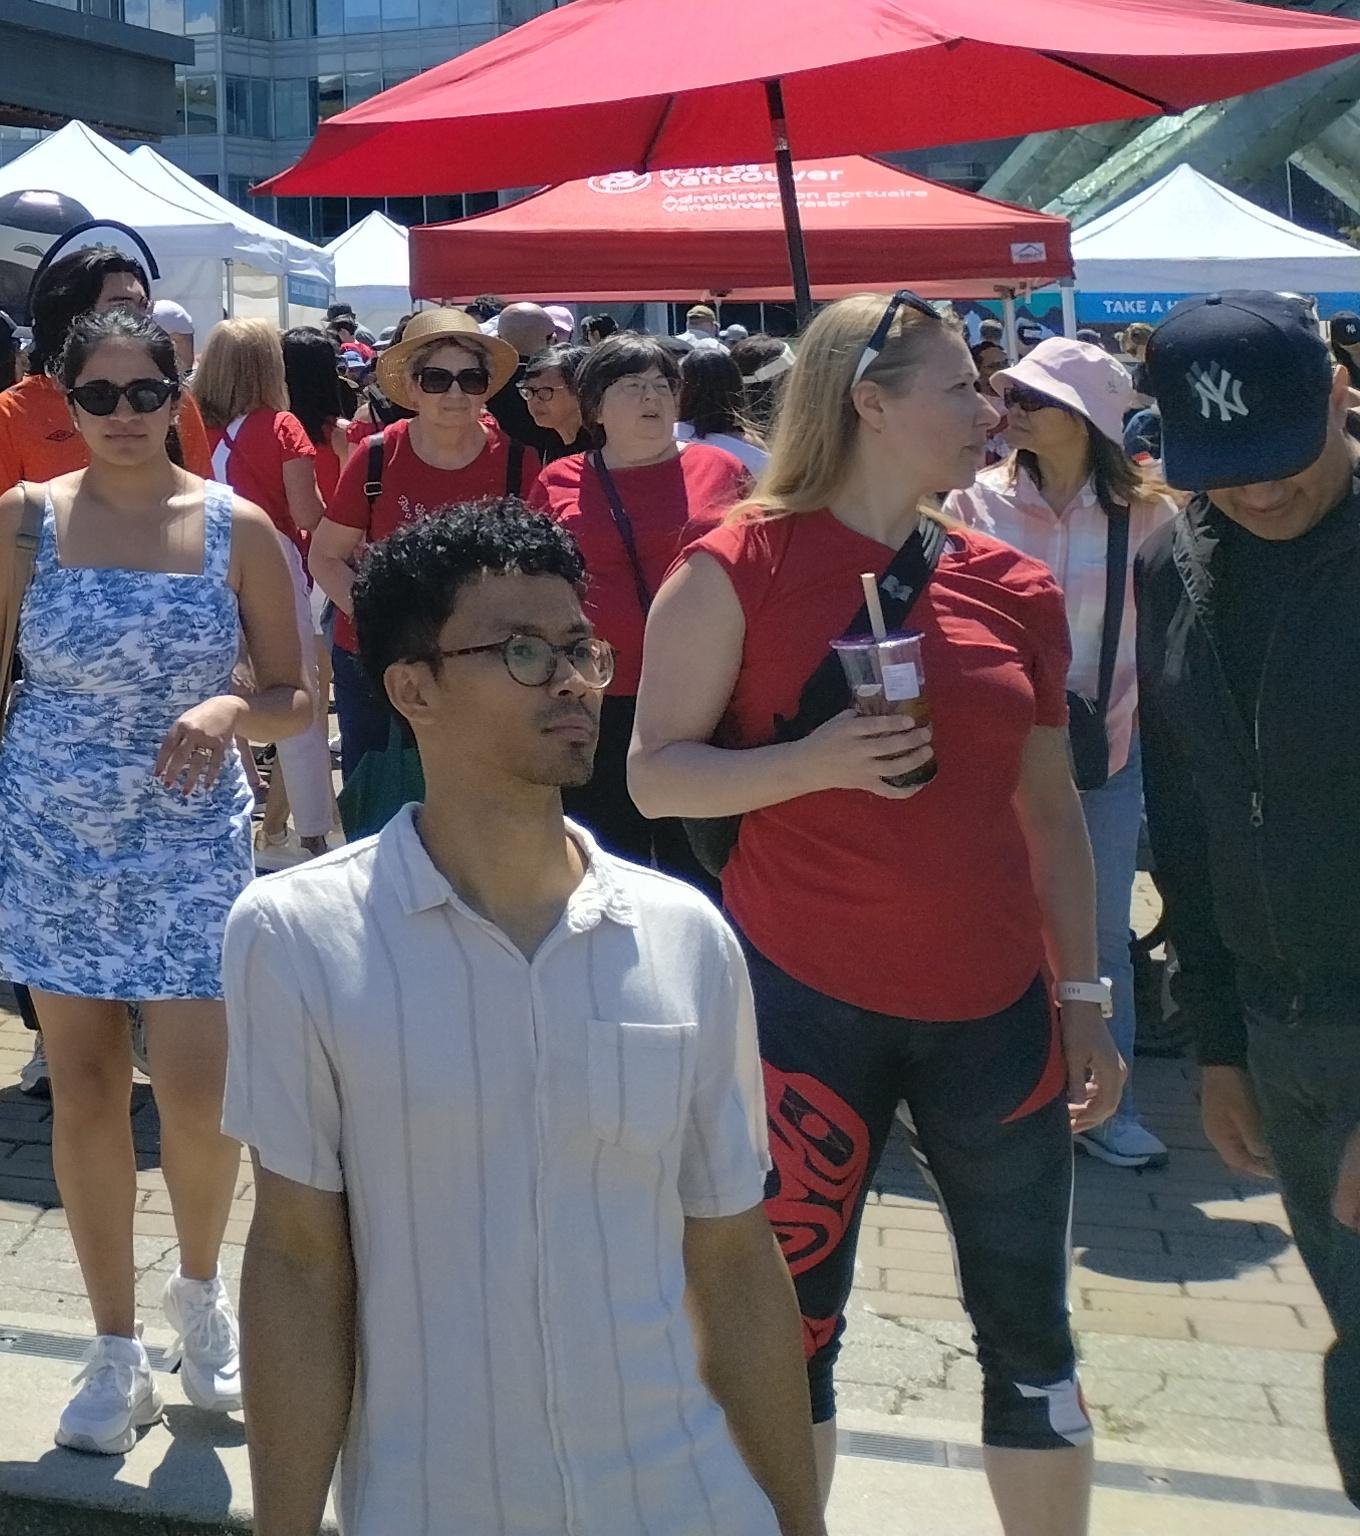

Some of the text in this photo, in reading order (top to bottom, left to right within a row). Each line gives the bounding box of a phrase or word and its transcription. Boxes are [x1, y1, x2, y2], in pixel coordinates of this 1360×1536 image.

[826, 189, 928, 202] portuaire
[1103, 300, 1147, 314] TAKE
[1150, 300, 1164, 313] A
[1191, 365, 1250, 422] NY
